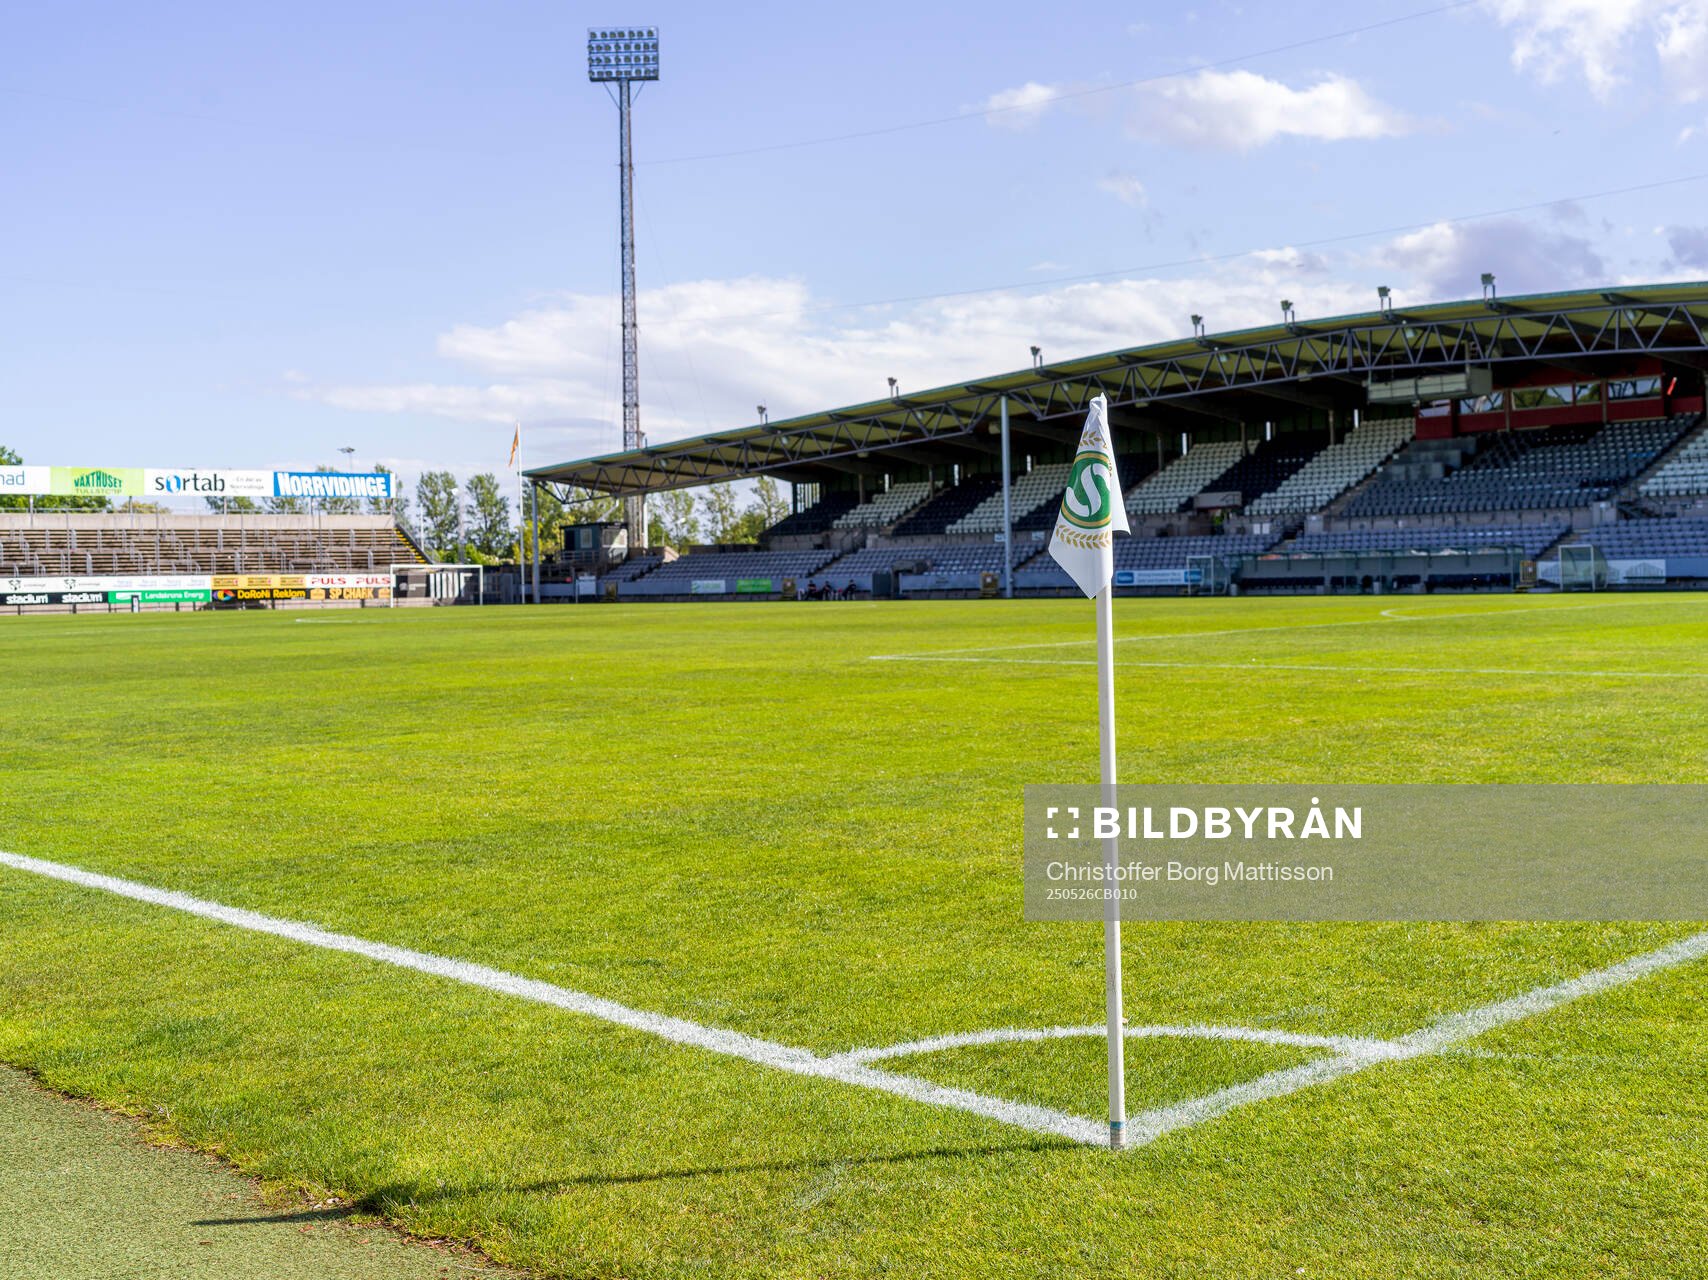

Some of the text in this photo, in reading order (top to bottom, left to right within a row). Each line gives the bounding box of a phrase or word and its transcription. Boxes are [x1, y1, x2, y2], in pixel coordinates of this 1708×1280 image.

[155, 473, 225, 493] sortab
[277, 472, 388, 497] NORRVIDINGE
[311, 577, 346, 585] PULS
[6, 594, 48, 604] stadium
[62, 593, 102, 603] stadium
[273, 589, 305, 599] Reklam
